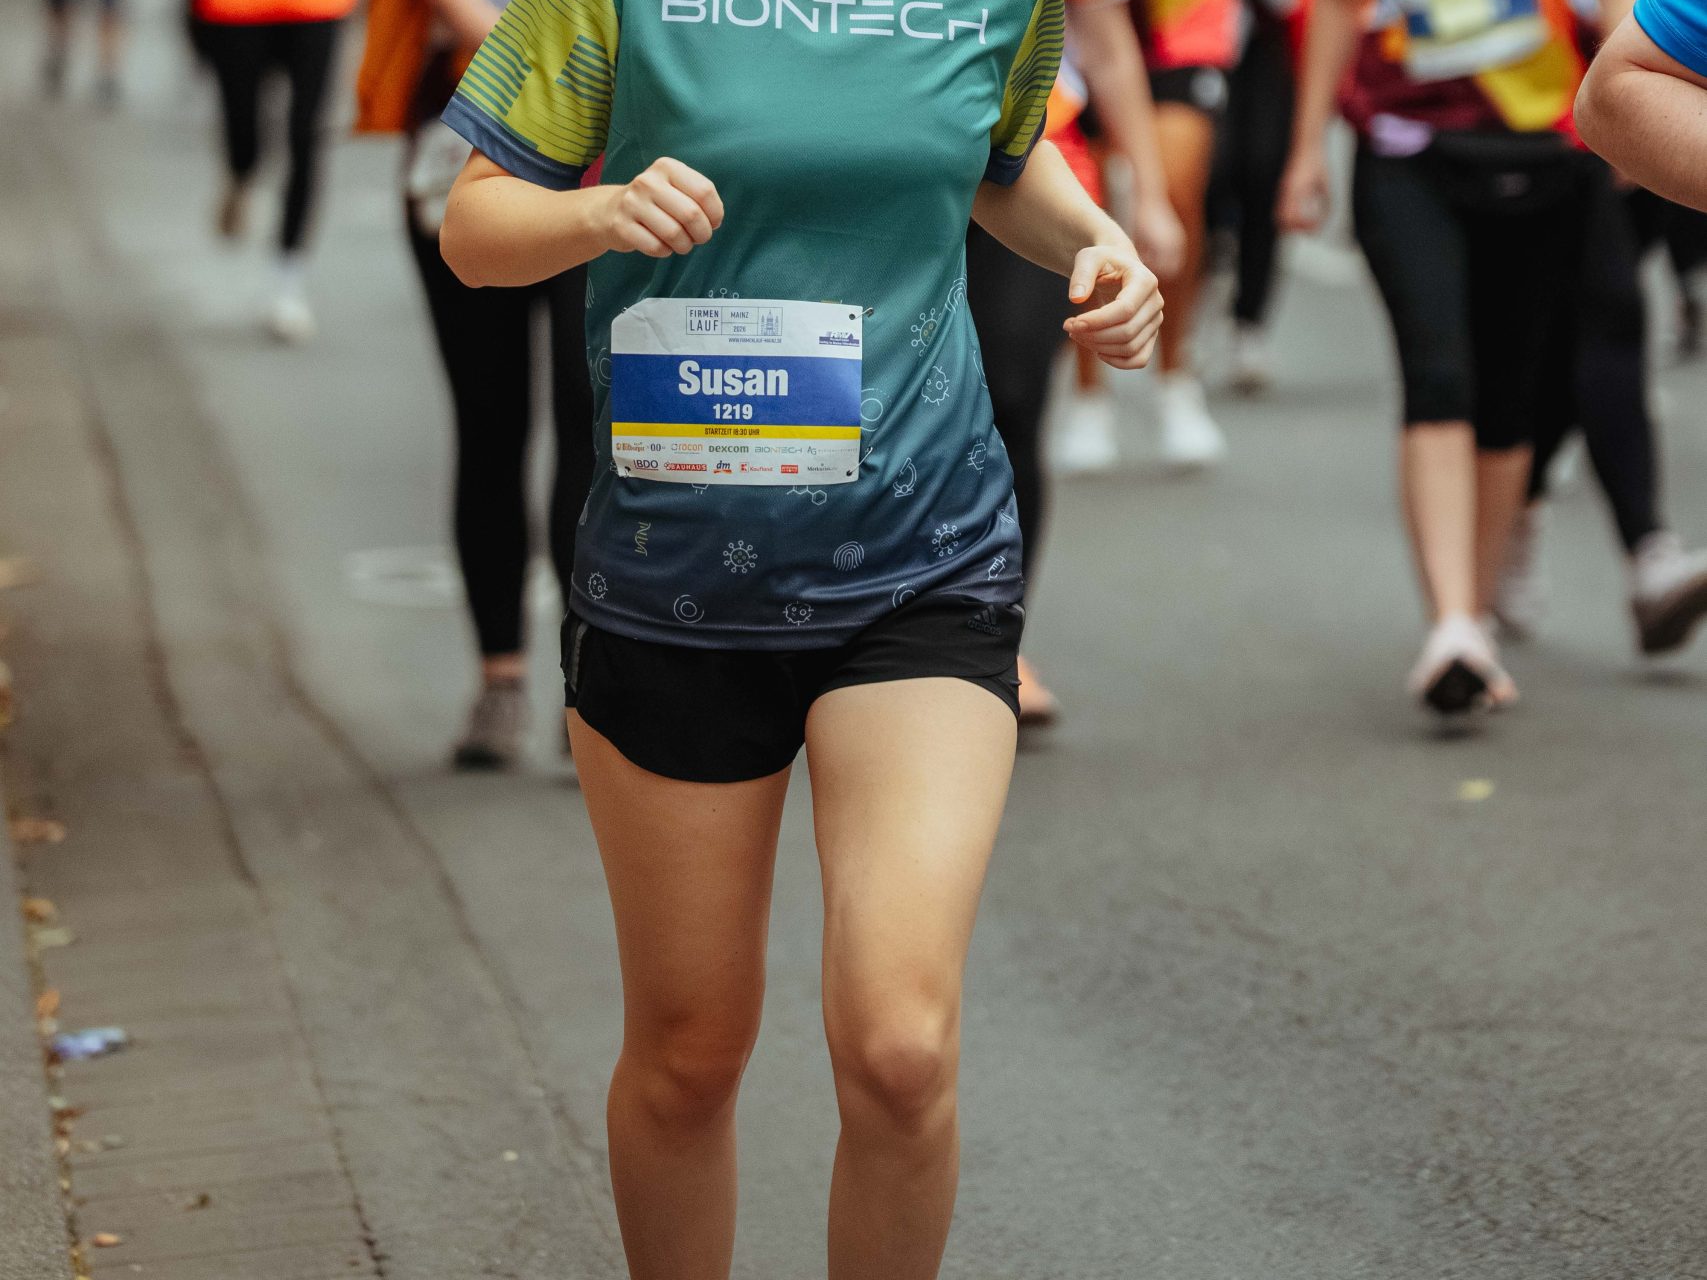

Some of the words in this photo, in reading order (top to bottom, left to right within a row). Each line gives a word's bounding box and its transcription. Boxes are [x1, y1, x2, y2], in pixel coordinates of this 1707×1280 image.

[689, 309, 719, 318] FIRMEN
[730, 311, 749, 319] MAINZ
[690, 319, 719, 332] LAUF
[678, 360, 789, 397] Susan
[713, 403, 753, 420] 1219
[704, 427, 732, 436] STARTZEIT
[755, 446, 803, 454] BIONTECH
[636, 460, 659, 469] BDO
[671, 463, 706, 471] BAUHAUS
[716, 460, 731, 469] dm
